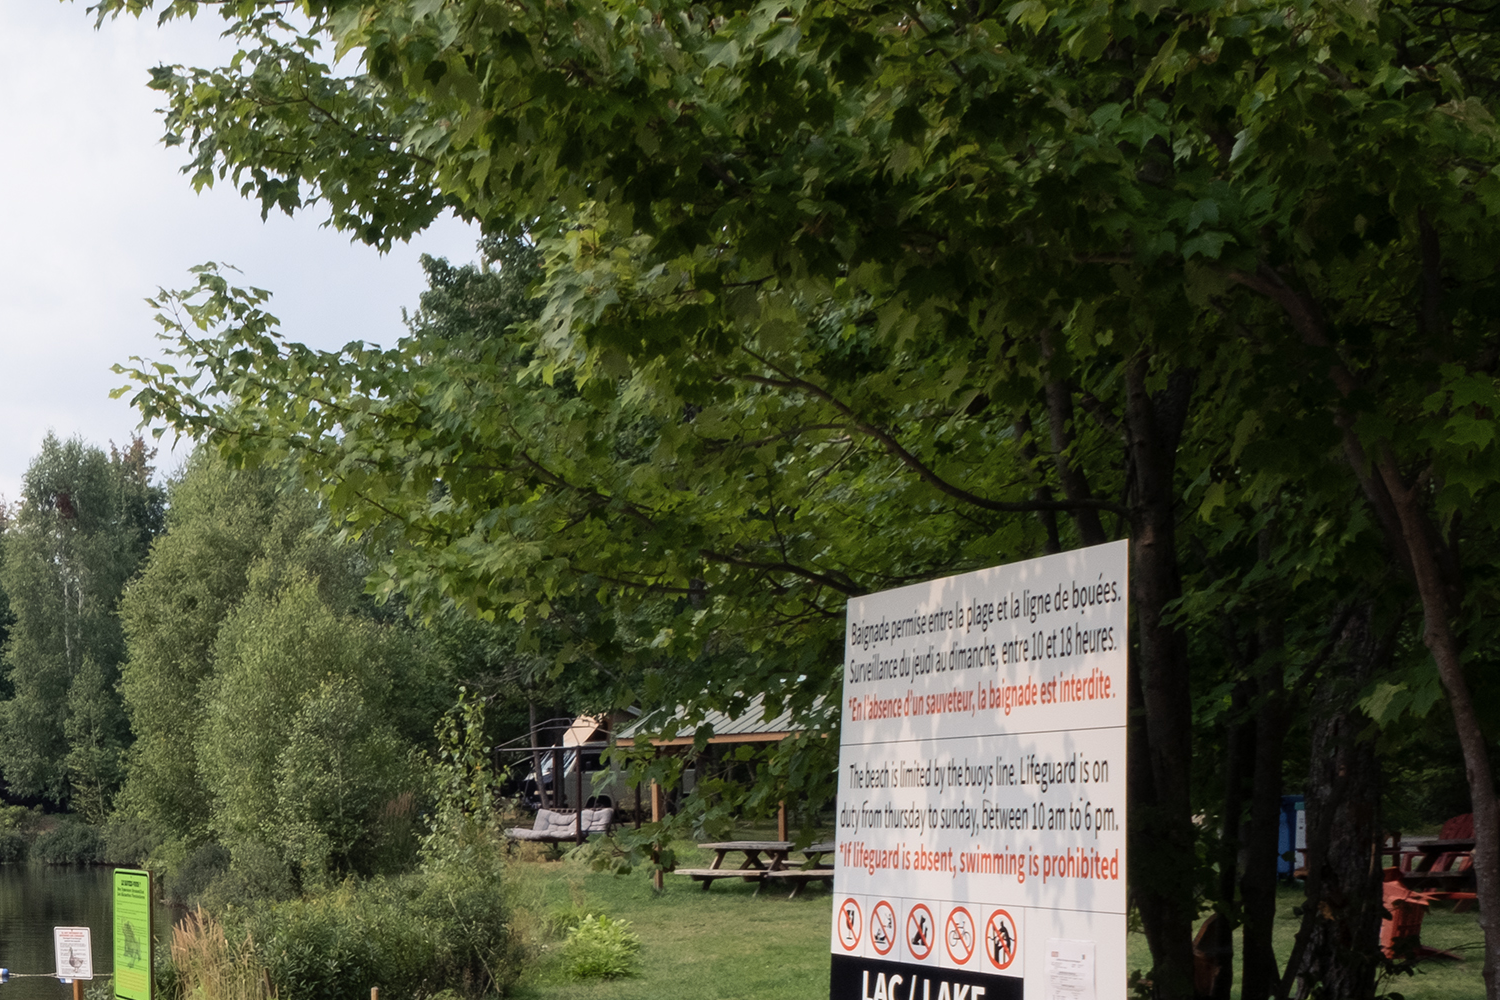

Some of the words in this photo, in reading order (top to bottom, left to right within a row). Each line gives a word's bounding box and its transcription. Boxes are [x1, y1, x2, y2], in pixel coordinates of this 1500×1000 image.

[852, 615, 889, 651] Baignade
[891, 609, 926, 646] permise
[928, 607, 953, 633] entre
[955, 601, 964, 628] la
[967, 598, 994, 633] plage
[997, 596, 1008, 621] et
[1010, 592, 1020, 619] la
[1023, 589, 1051, 623] ligne
[1054, 583, 1069, 612] de
[1072, 572, 1121, 609] bouées.
[849, 653, 898, 684] Surveillance
[899, 649, 910, 677] du
[910, 645, 934, 684] jeudi
[935, 651, 947, 672] au
[948, 637, 999, 672] dimanche,
[1002, 635, 1029, 665] entre
[1031, 630, 1044, 661] 10
[1046, 629, 1057, 659] et
[1060, 626, 1072, 657] 18
[1075, 622, 1117, 655] heures.
[863, 693, 902, 721] l'absence
[903, 689, 924, 717] d'un
[926, 687, 976, 718] sauveteur,
[977, 681, 986, 710] la
[989, 675, 1038, 716] baignade
[1040, 675, 1057, 704] est
[849, 762, 864, 789] The
[865, 761, 889, 788] beach
[891, 761, 898, 788] is
[900, 759, 931, 788] limited
[934, 758, 946, 794] by
[947, 757, 963, 787] the
[964, 757, 994, 794] buoys
[996, 756, 1018, 786] line.
[1020, 752, 1076, 793] Lifeguard
[1080, 752, 1089, 783] is
[1092, 759, 1109, 783] on
[840, 801, 860, 835] duty
[861, 800, 882, 828] from
[885, 801, 927, 836] thursday
[928, 803, 938, 829] to
[940, 800, 979, 837] sunday,
[982, 800, 1028, 830] between
[1032, 801, 1045, 830] 10
[1048, 807, 1066, 830] am
[1069, 802, 1081, 831] to
[1084, 801, 1092, 831] 6
[1095, 807, 1119, 840] pm.
[853, 841, 899, 875] lifeguard
[902, 842, 911, 870] is
[913, 843, 957, 879] absent,
[960, 845, 1025, 884] swimming
[1029, 846, 1039, 877] is
[1043, 847, 1119, 884] prohibited
